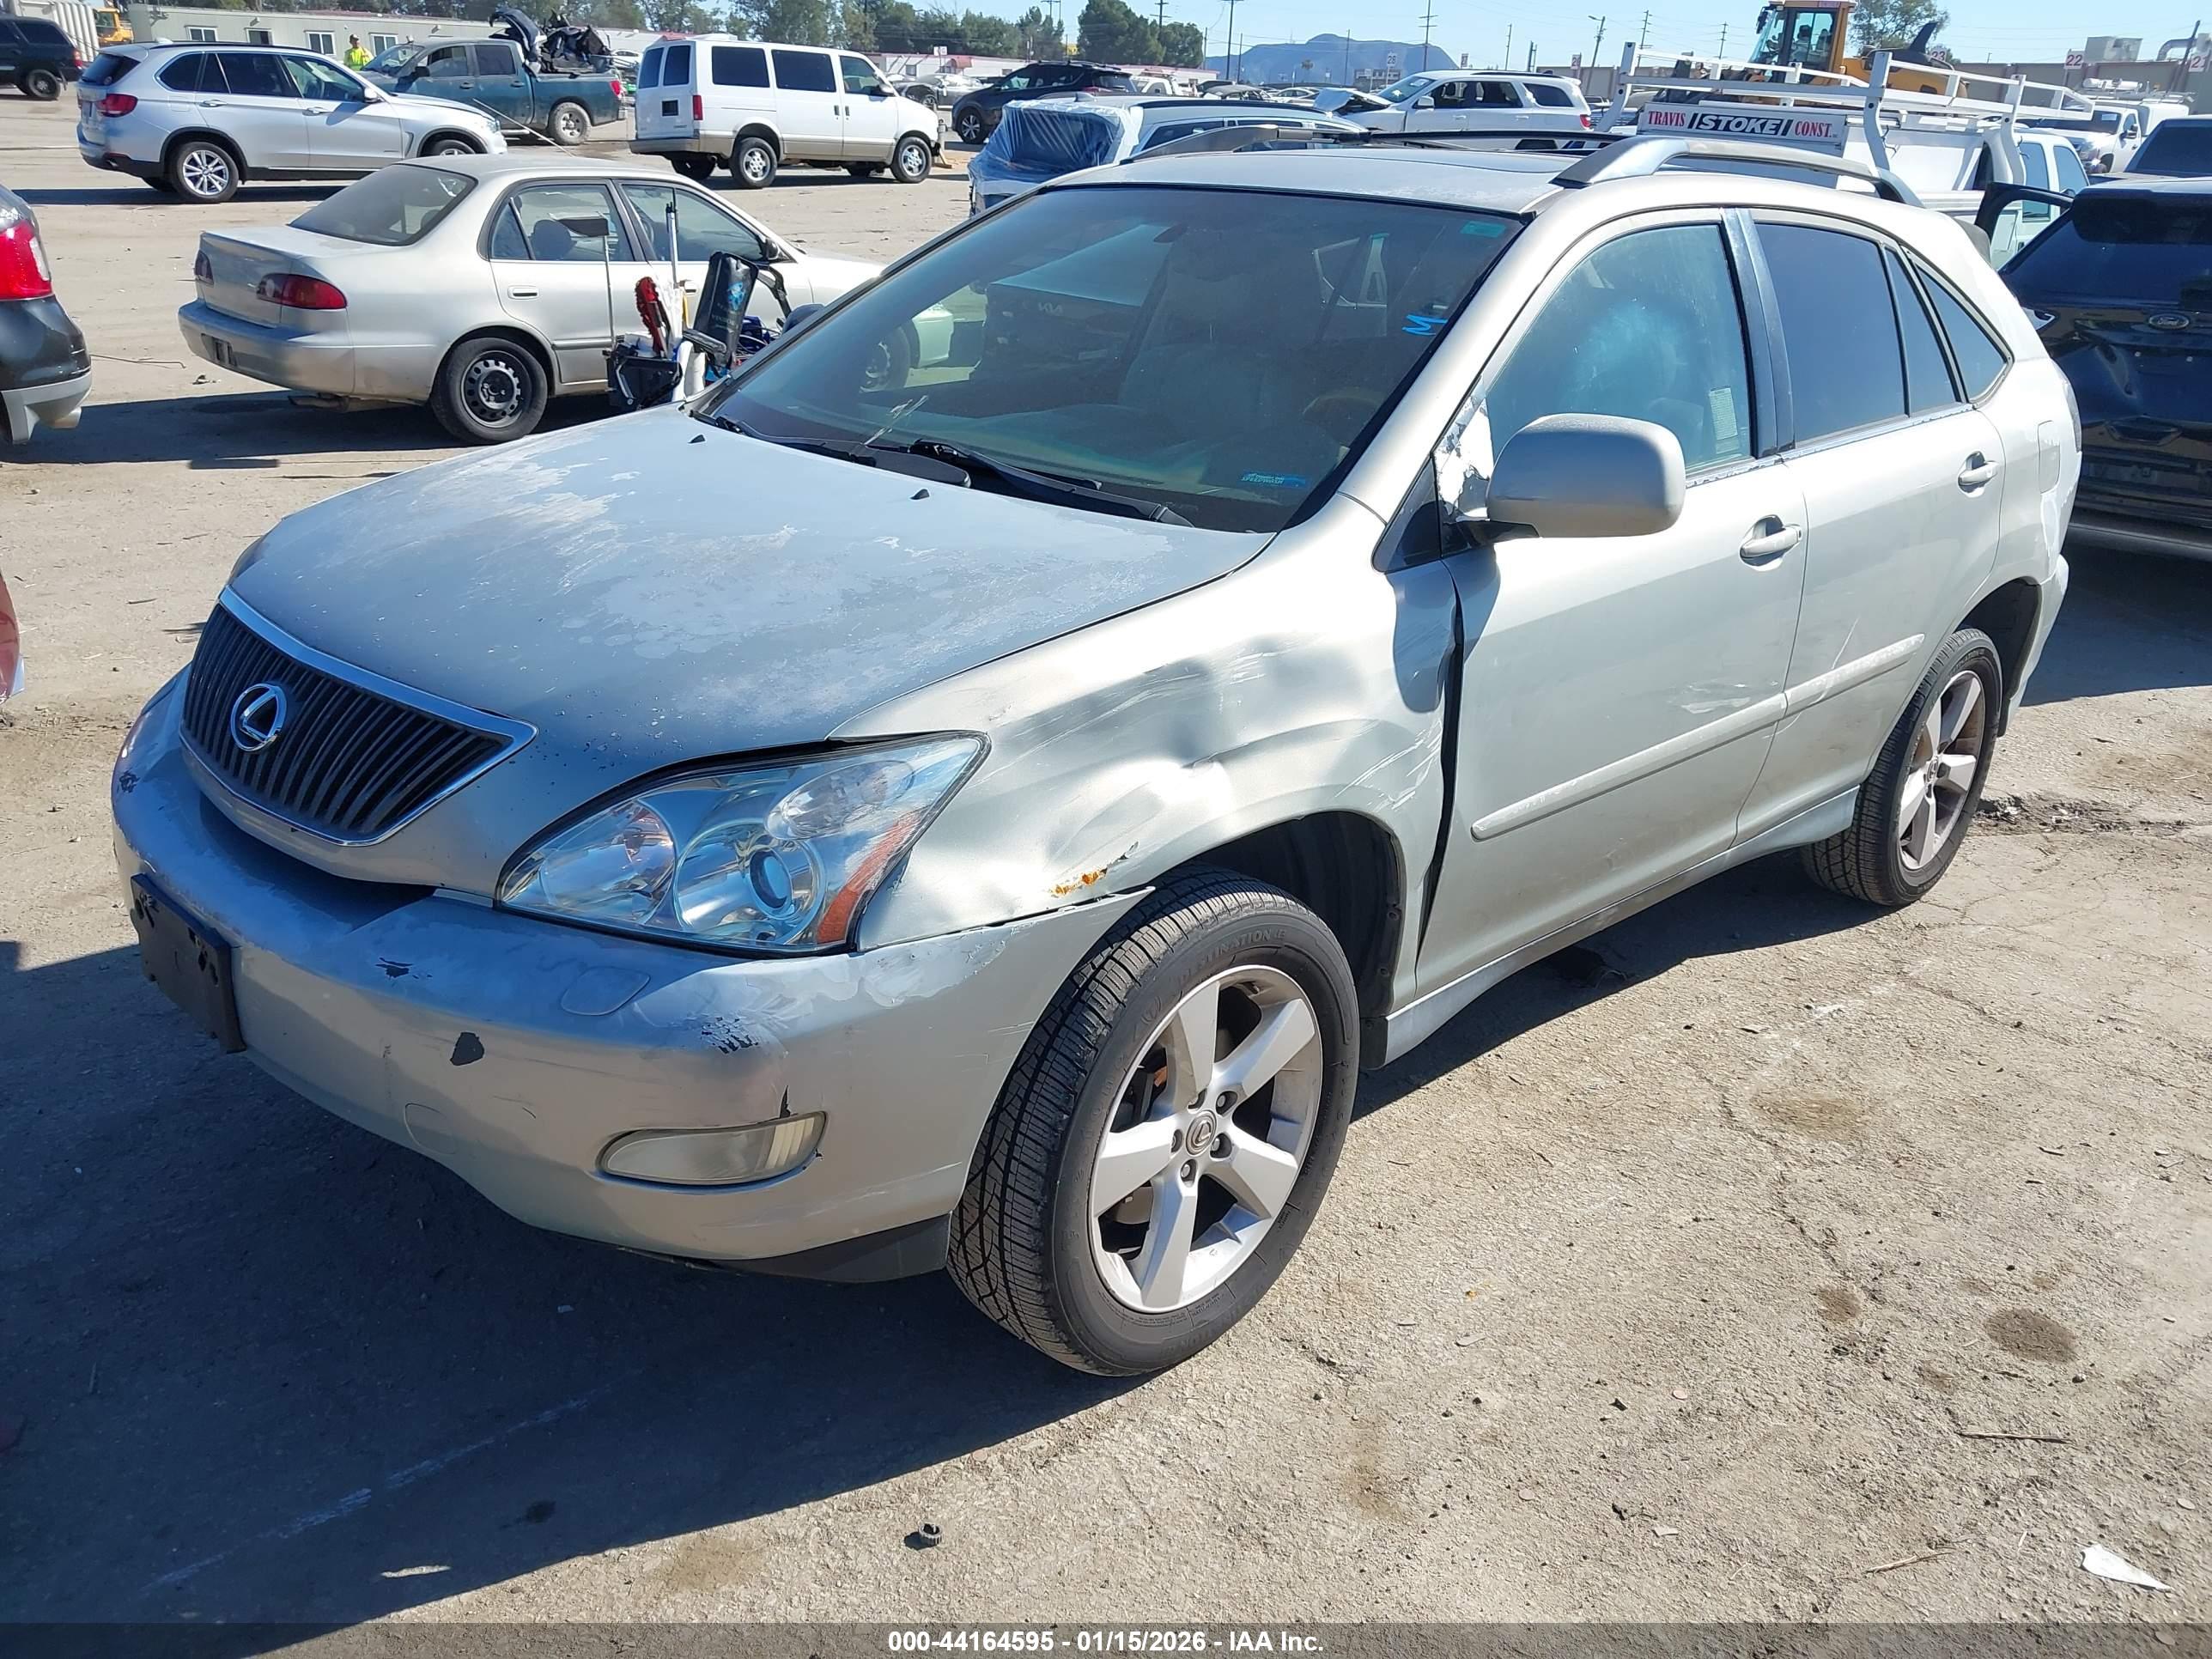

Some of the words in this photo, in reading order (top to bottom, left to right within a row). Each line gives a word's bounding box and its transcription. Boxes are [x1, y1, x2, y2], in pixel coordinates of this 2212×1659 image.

[1388, 56, 1396, 64] 28
[2065, 54, 2082, 66] 22
[1648, 111, 1686, 127] TRAVIS
[1698, 114, 1777, 135] STOKE
[1794, 120, 1832, 138] CONST.
